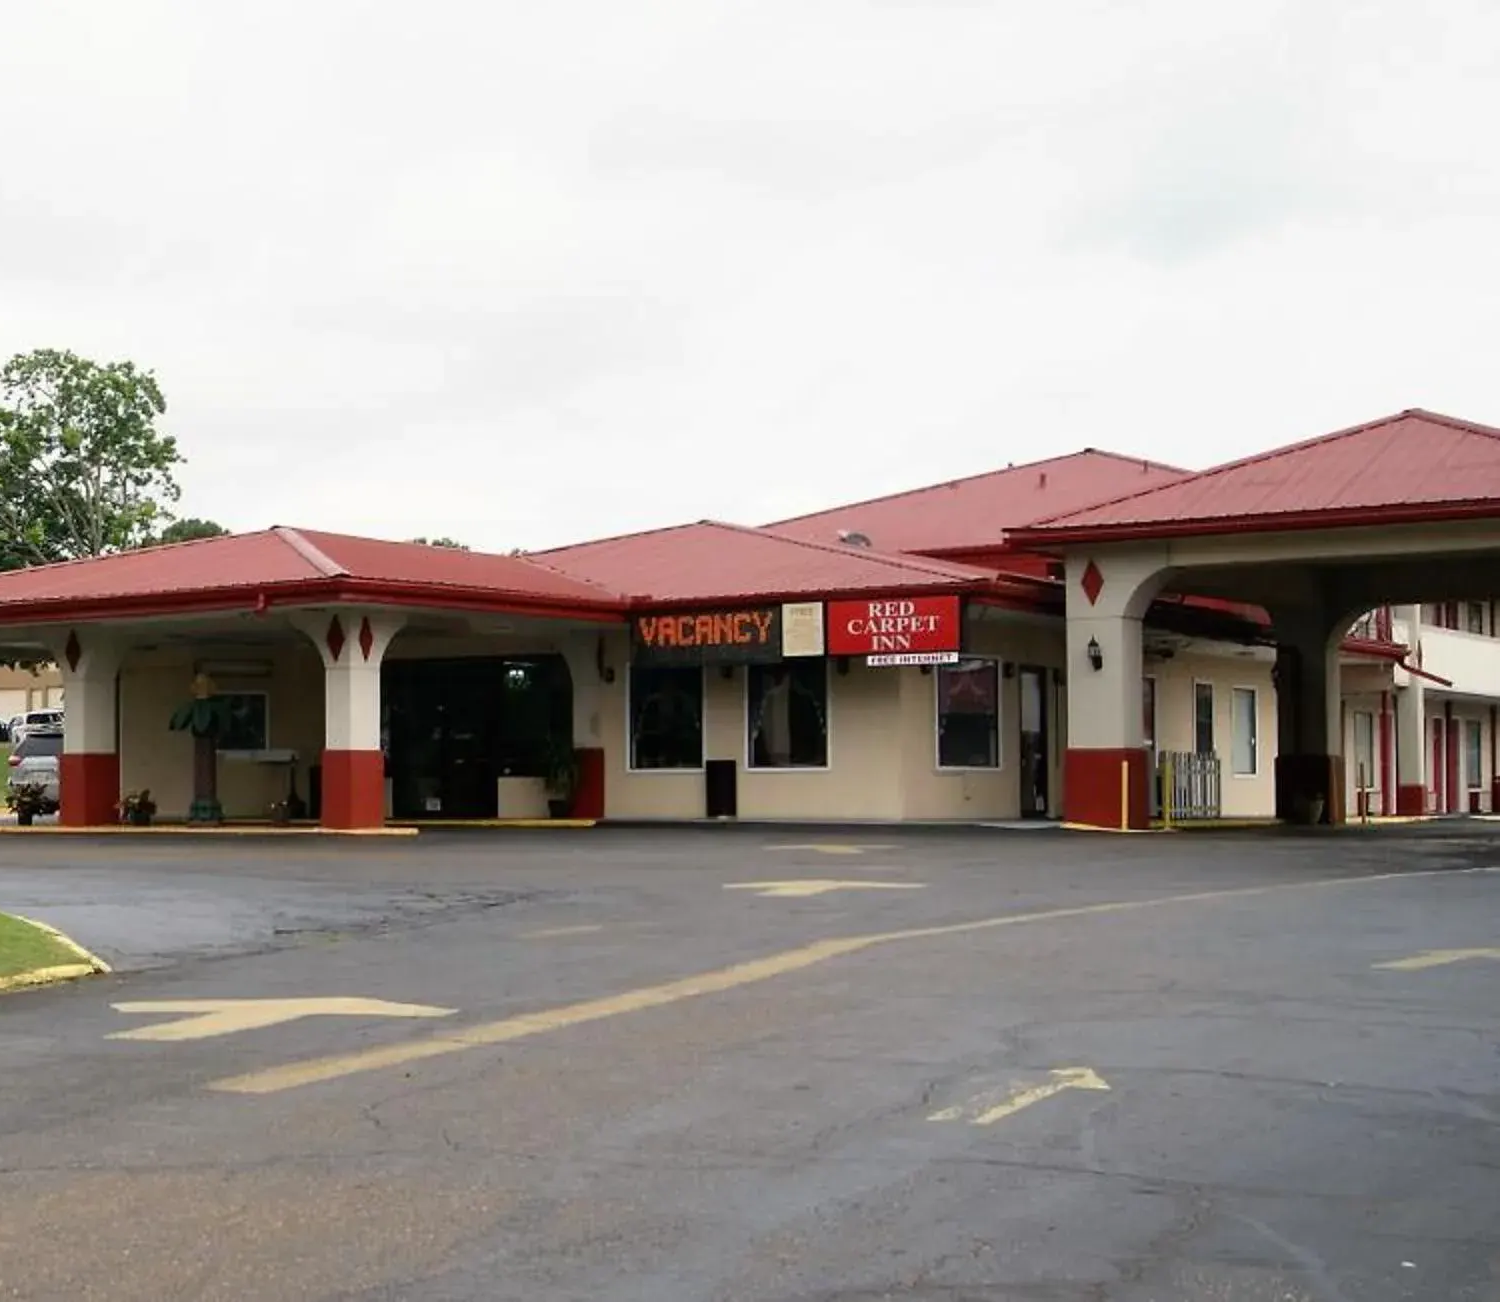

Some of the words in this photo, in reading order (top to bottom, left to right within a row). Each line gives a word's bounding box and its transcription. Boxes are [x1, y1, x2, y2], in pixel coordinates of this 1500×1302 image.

[868, 601, 915, 618] RED
[640, 611, 772, 647] VACANCY
[847, 615, 939, 635] CARPET
[871, 634, 911, 650] INN
